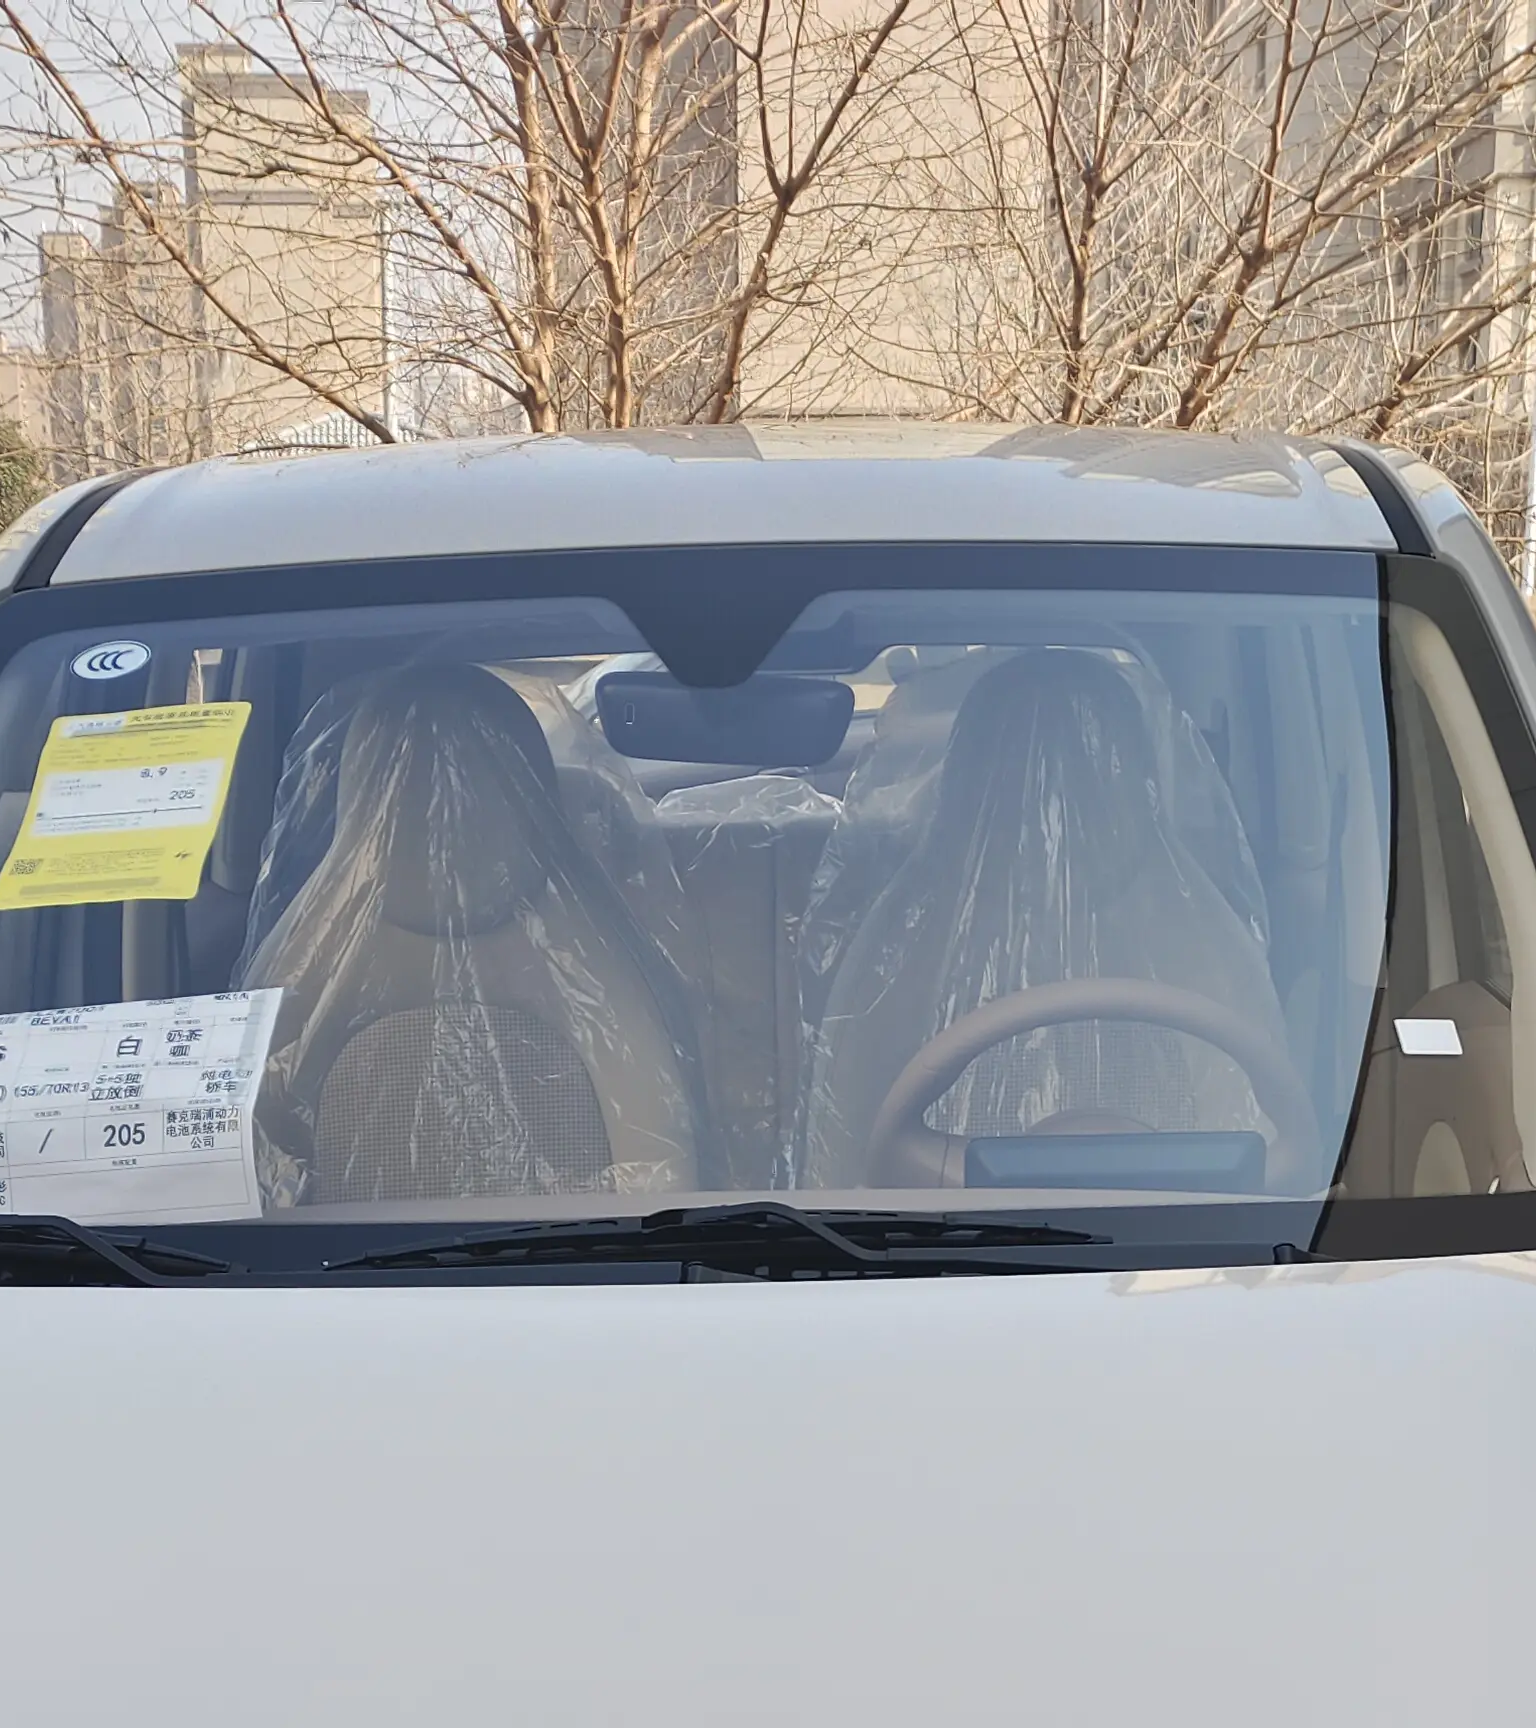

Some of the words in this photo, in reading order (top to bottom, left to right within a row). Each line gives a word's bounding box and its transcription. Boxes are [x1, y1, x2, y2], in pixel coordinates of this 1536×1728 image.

[169, 789, 196, 801] 205
[115, 1036, 144, 1060] 白
[166, 1105, 239, 1124] 赛克瑞浦动力
[102, 1122, 145, 1148] 205
[165, 1119, 240, 1138] 电池系统有限
[190, 1136, 215, 1149] 公司
